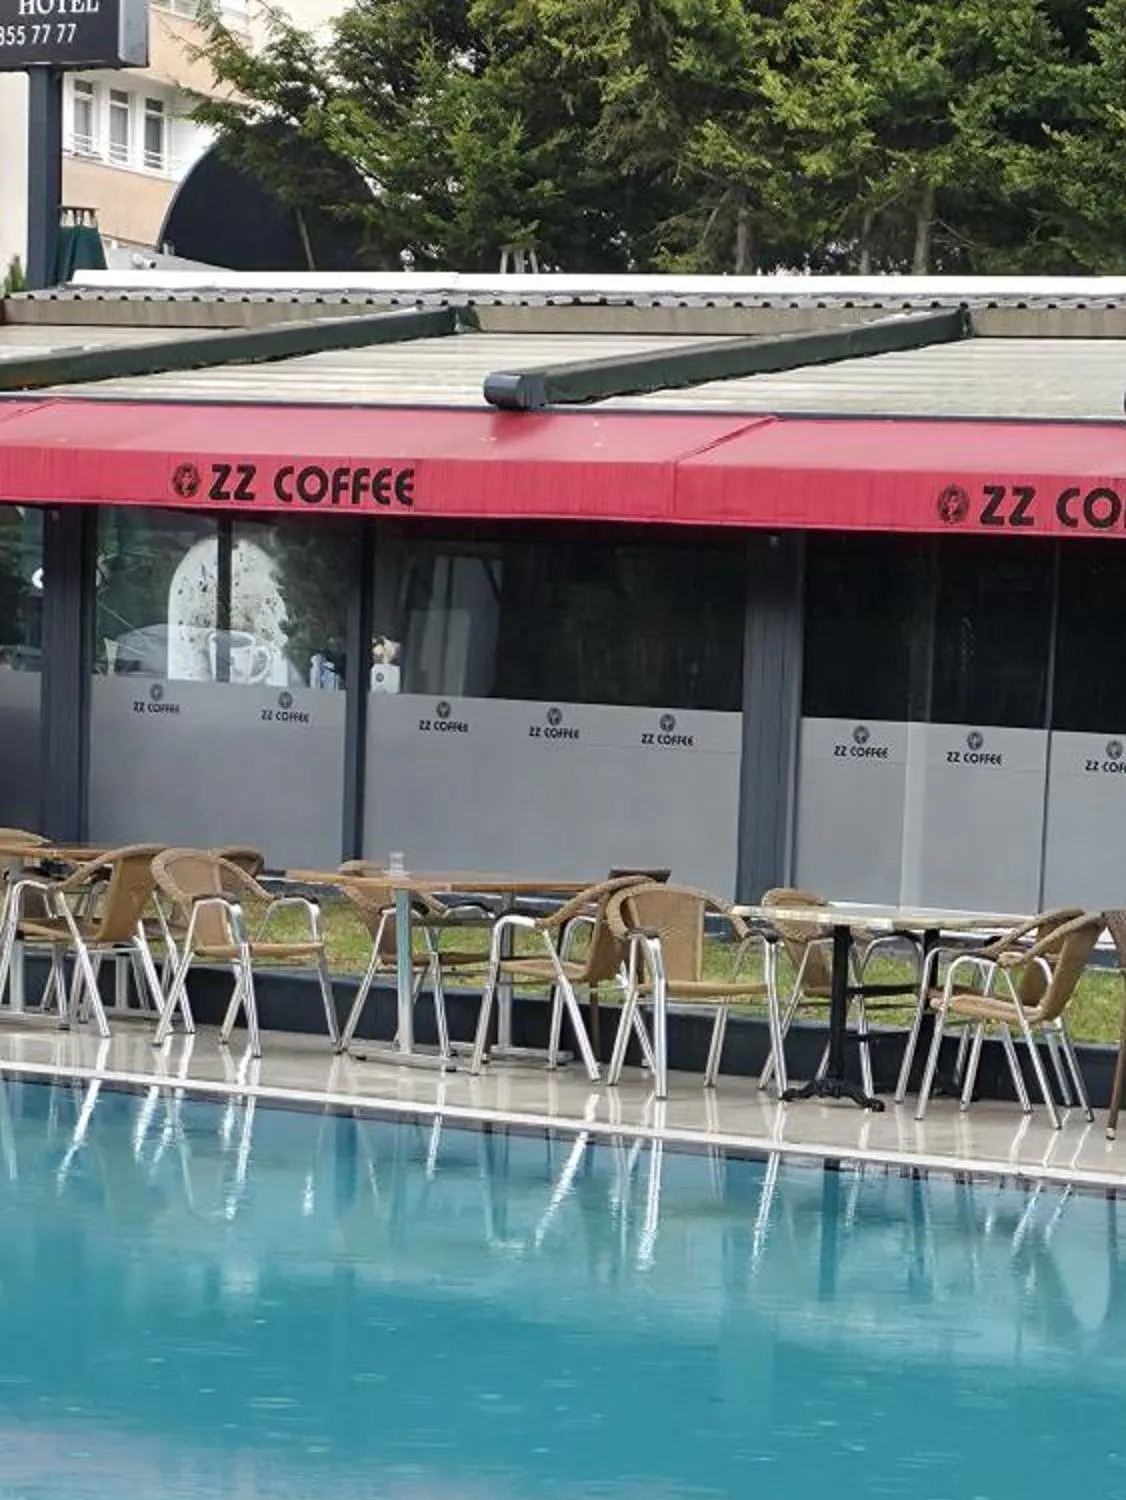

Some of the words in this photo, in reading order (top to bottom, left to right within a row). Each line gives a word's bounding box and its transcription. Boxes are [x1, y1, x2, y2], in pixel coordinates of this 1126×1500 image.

[31, 23, 51, 44] 77
[57, 23, 77, 43] 77
[208, 464, 256, 501] ZZ
[273, 466, 416, 506] COFFEE
[980, 485, 1036, 527] ZZ
[133, 702, 145, 714] ZZ
[147, 703, 180, 714] COFFEE
[261, 710, 273, 721] ZZ
[275, 711, 310, 724] COFFEE
[419, 720, 432, 731] ZZ
[433, 720, 469, 733] COFFEE
[528, 726, 542, 737] ZZ
[543, 727, 580, 740] COFFEE
[641, 734, 655, 745] ZZ
[656, 733, 694, 747] COFFEE
[833, 746, 848, 757] ZZ
[849, 745, 889, 759] COFFEE
[946, 752, 961, 763] ZZ
[963, 752, 1002, 766] COFFEE
[1084, 760, 1100, 772] ZZ
